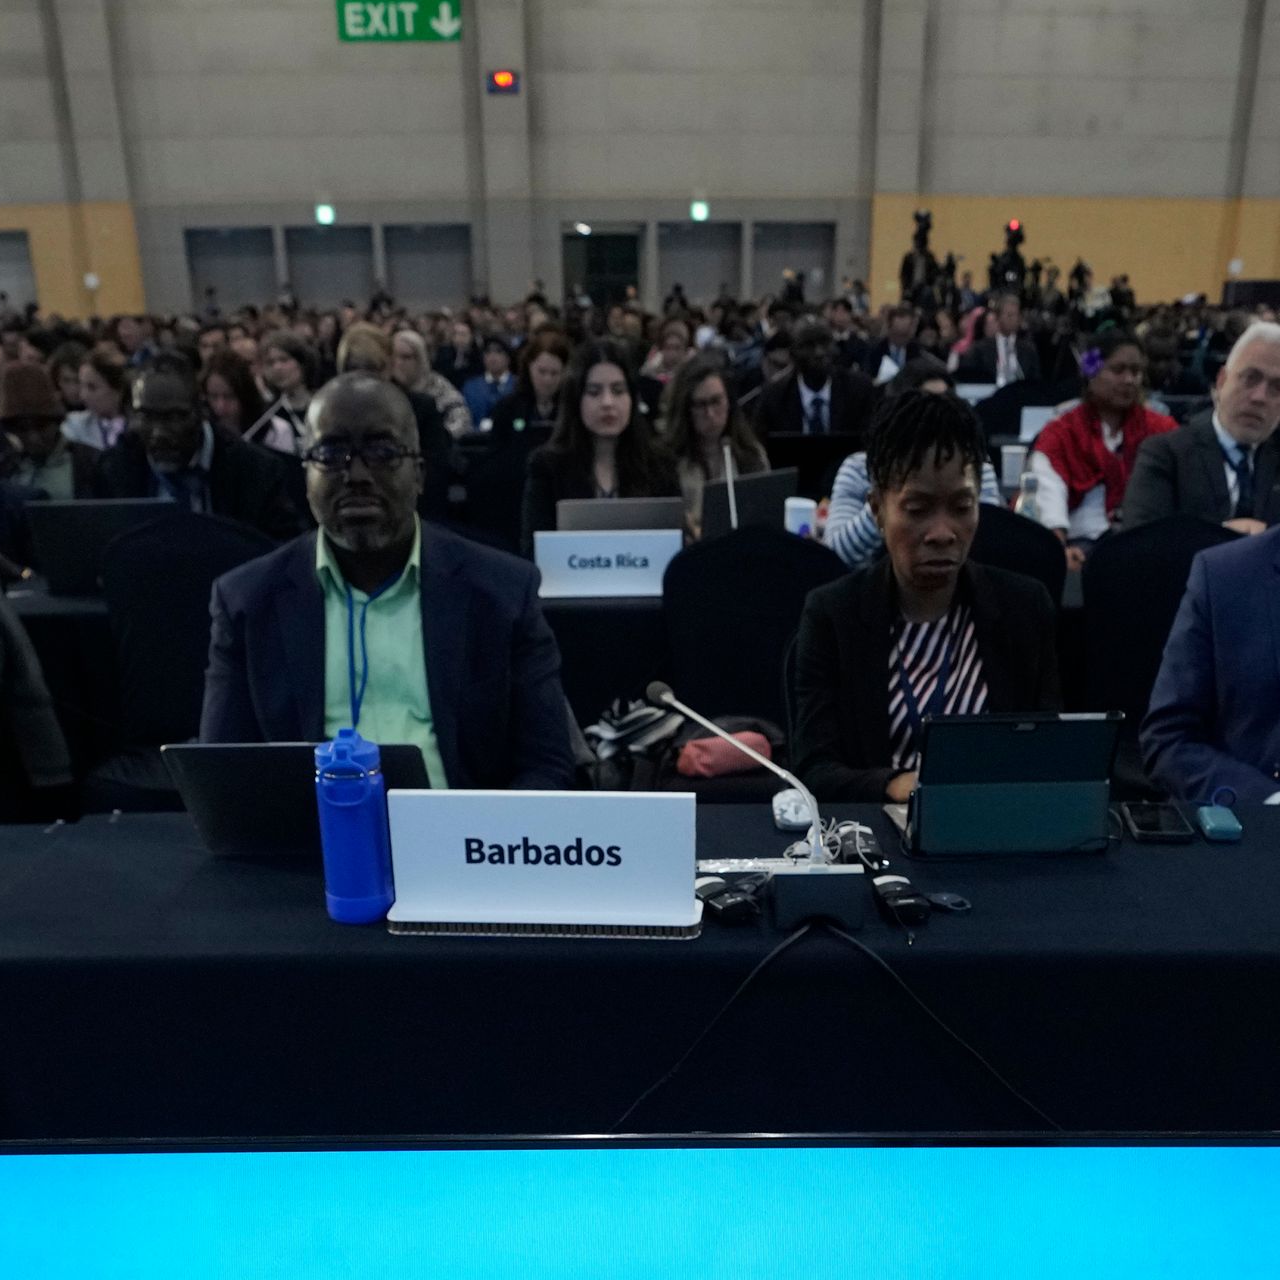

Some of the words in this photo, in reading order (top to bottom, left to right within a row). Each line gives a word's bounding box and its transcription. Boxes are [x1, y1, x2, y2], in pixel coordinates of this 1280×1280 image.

[344, 2, 418, 36] EXIT
[568, 554, 612, 569] Costa
[616, 552, 649, 568] Rica
[464, 836, 622, 866] Barbados
